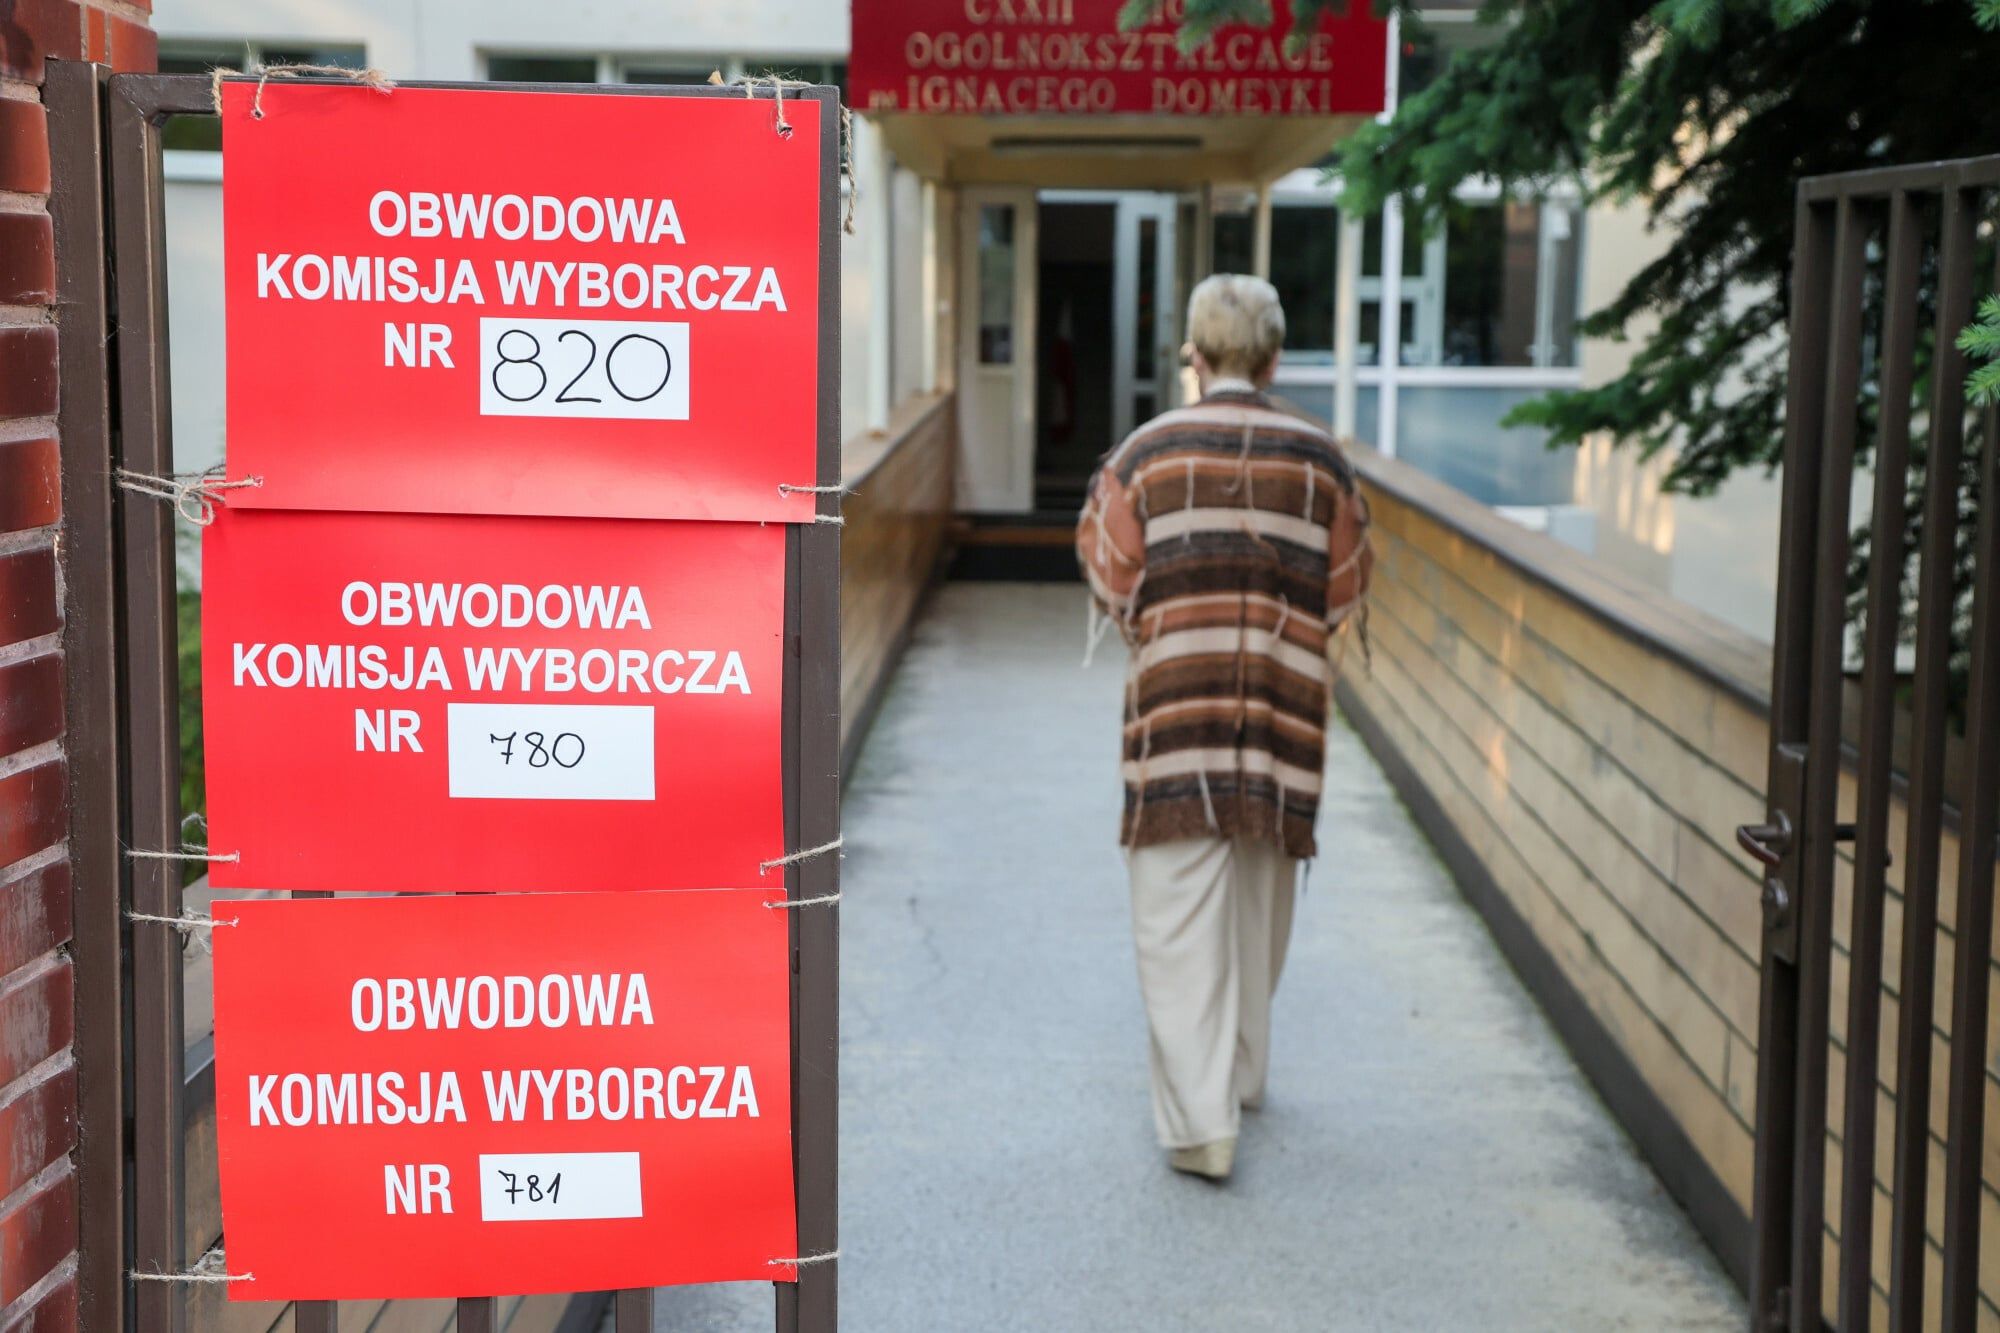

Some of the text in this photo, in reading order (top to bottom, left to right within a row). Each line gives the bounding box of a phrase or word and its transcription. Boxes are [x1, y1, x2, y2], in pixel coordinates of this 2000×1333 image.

[907, 75, 1117, 113] IGNACEGO
[1152, 77, 1332, 114] DOMEYKI
[369, 190, 686, 244] OBWODOWA
[256, 253, 788, 312] KOMISJA WYBORCZA
[384, 323, 672, 403] NR 820
[341, 581, 652, 630] OBWODOWA
[233, 643, 752, 694] KOMISJA WYBORCZA
[355, 708, 586, 768] NR 780
[351, 973, 655, 1032] OBWODOWA
[248, 1065, 760, 1127] KOMISJA WYBORCZA
[384, 1163, 562, 1215] NR 781
